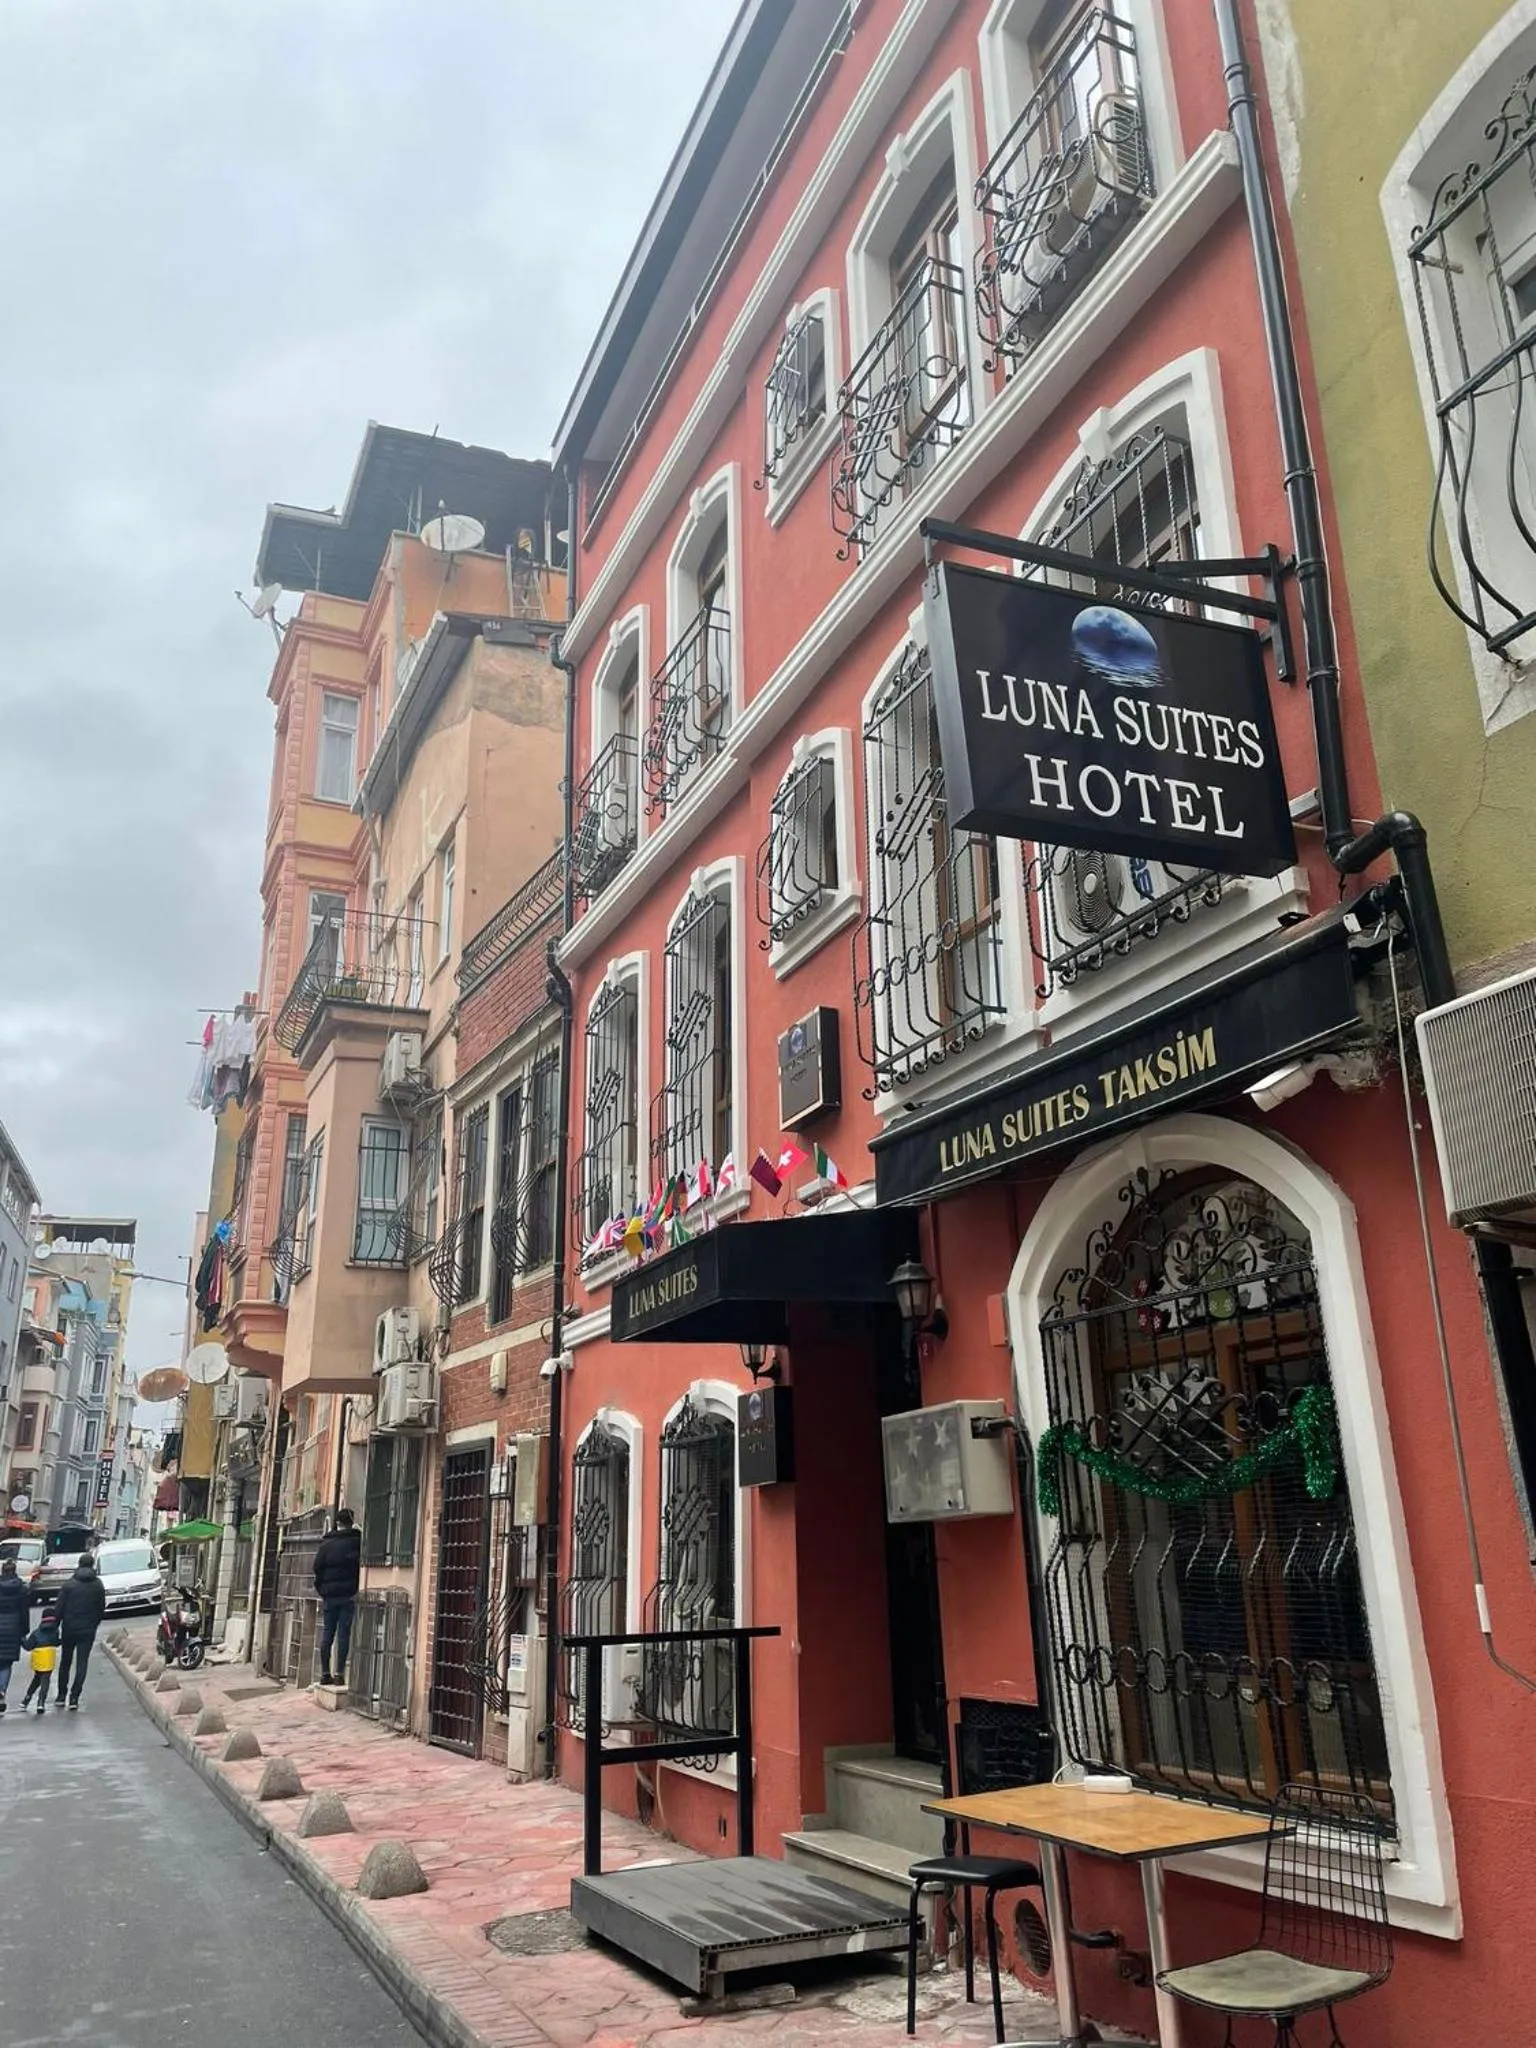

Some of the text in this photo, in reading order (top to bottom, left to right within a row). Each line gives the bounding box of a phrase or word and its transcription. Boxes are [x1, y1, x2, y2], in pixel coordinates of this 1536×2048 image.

[976, 670, 1265, 769] LUNA SUITES
[1023, 753, 1246, 839] HOTEL
[940, 1028, 1216, 1172] LUNA SUITES TAKSİM
[629, 1265, 698, 1318] LUNA SUITES
[99, 1460, 112, 1501] HOTEL
